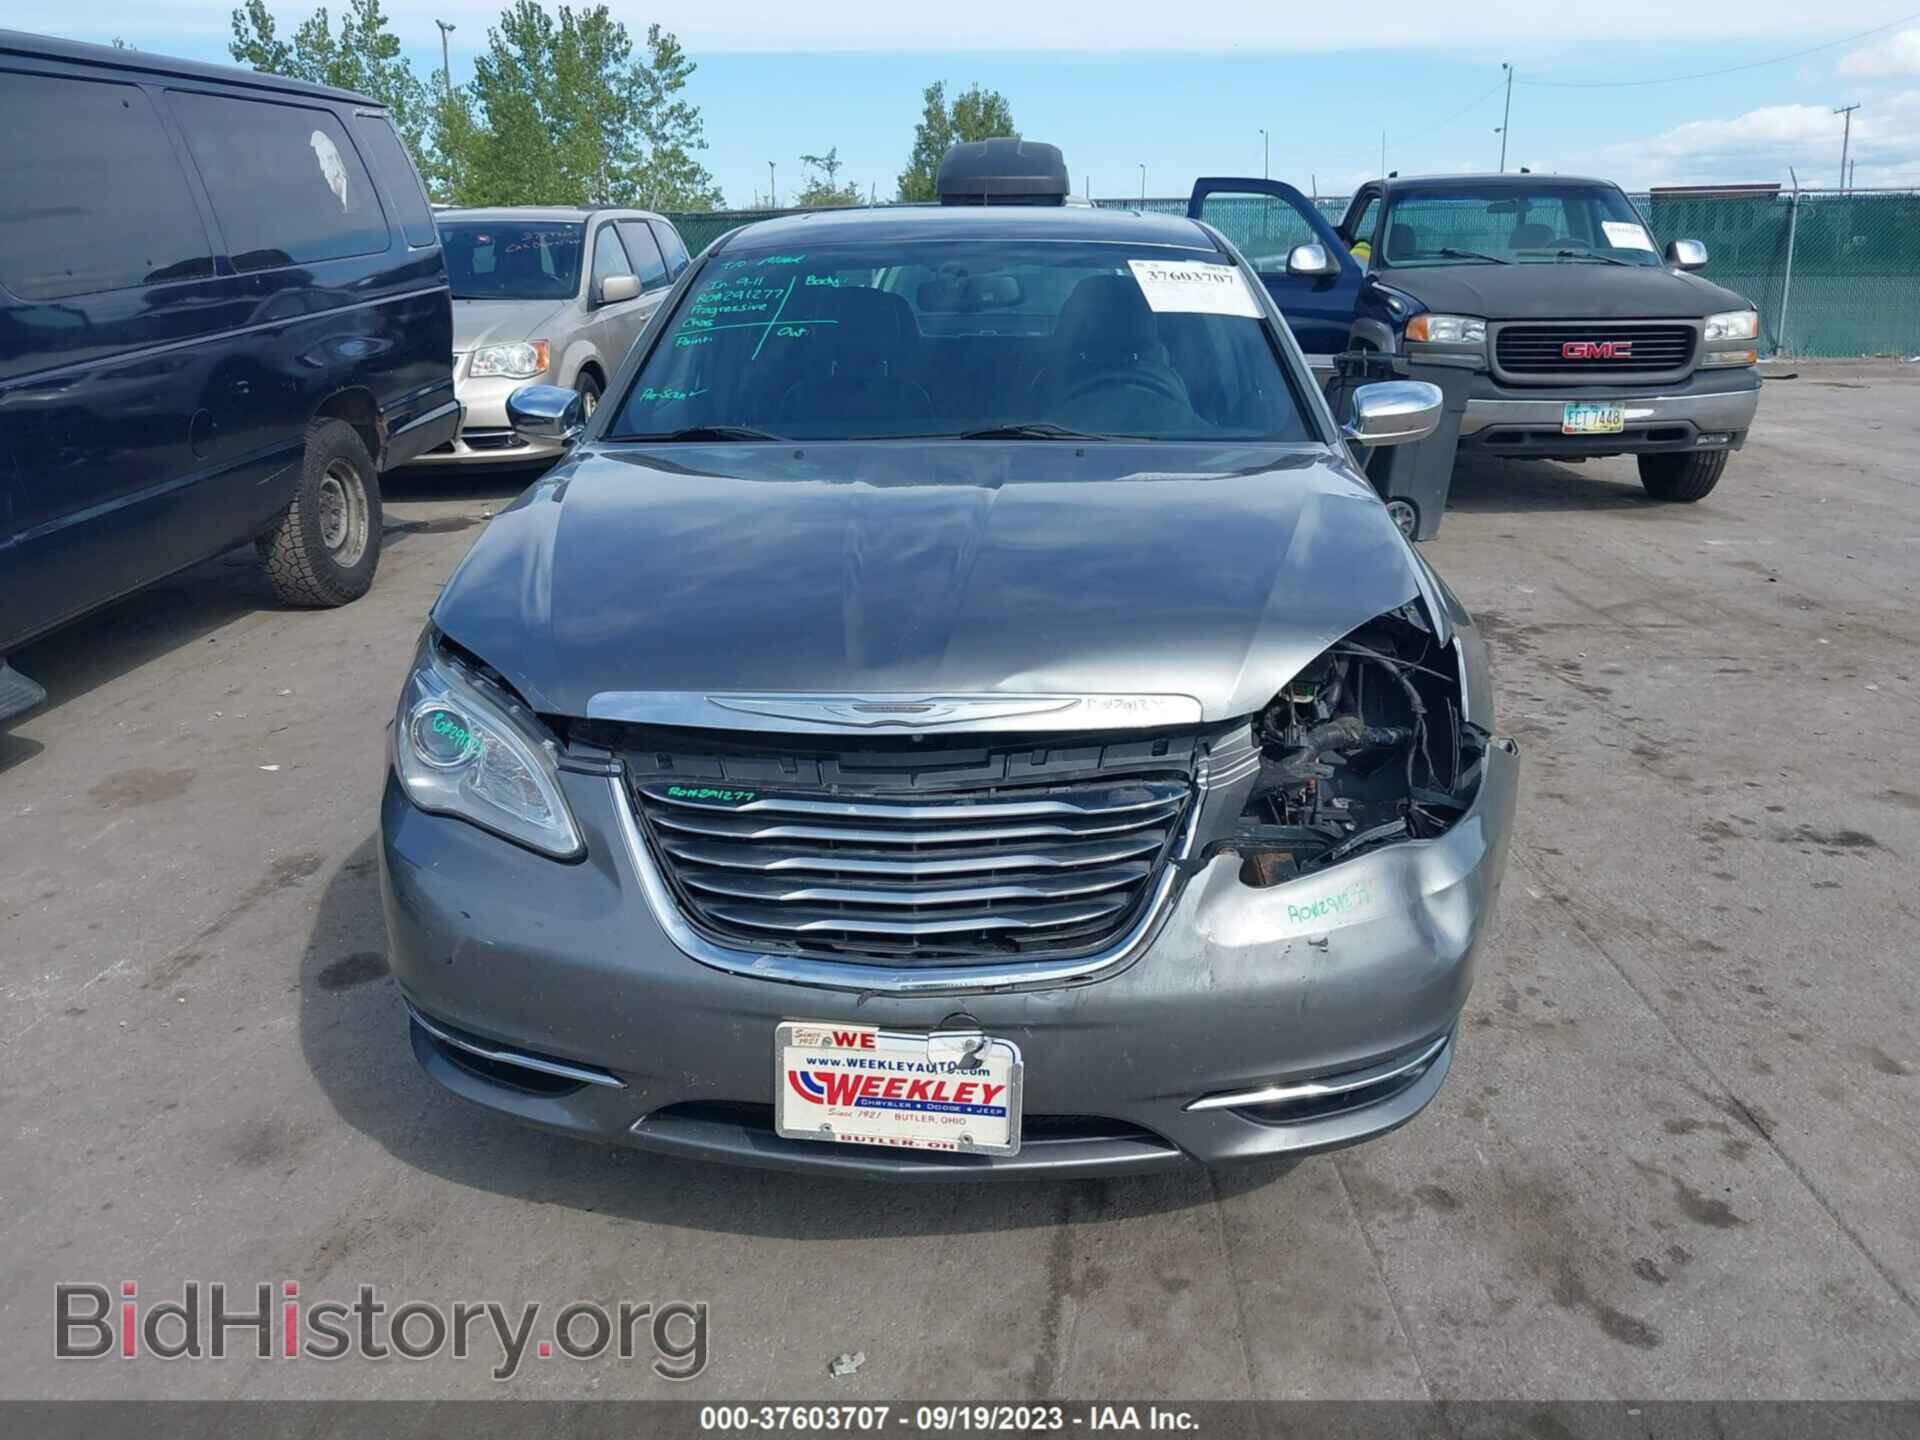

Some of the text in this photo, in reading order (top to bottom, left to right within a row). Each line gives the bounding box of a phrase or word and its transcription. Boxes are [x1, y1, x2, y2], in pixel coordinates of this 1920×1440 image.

[1146, 270, 1233, 285] 37603707
[1562, 341, 1632, 359] GMC
[832, 1031, 876, 1049] WE
[806, 1057, 990, 1076] www.WEEKLEYAUTO.com
[813, 1072, 1005, 1106] WEEKLEY
[894, 1113, 967, 1126] BUTLER, OHIO
[976, 1107, 1003, 1115] JEEP
